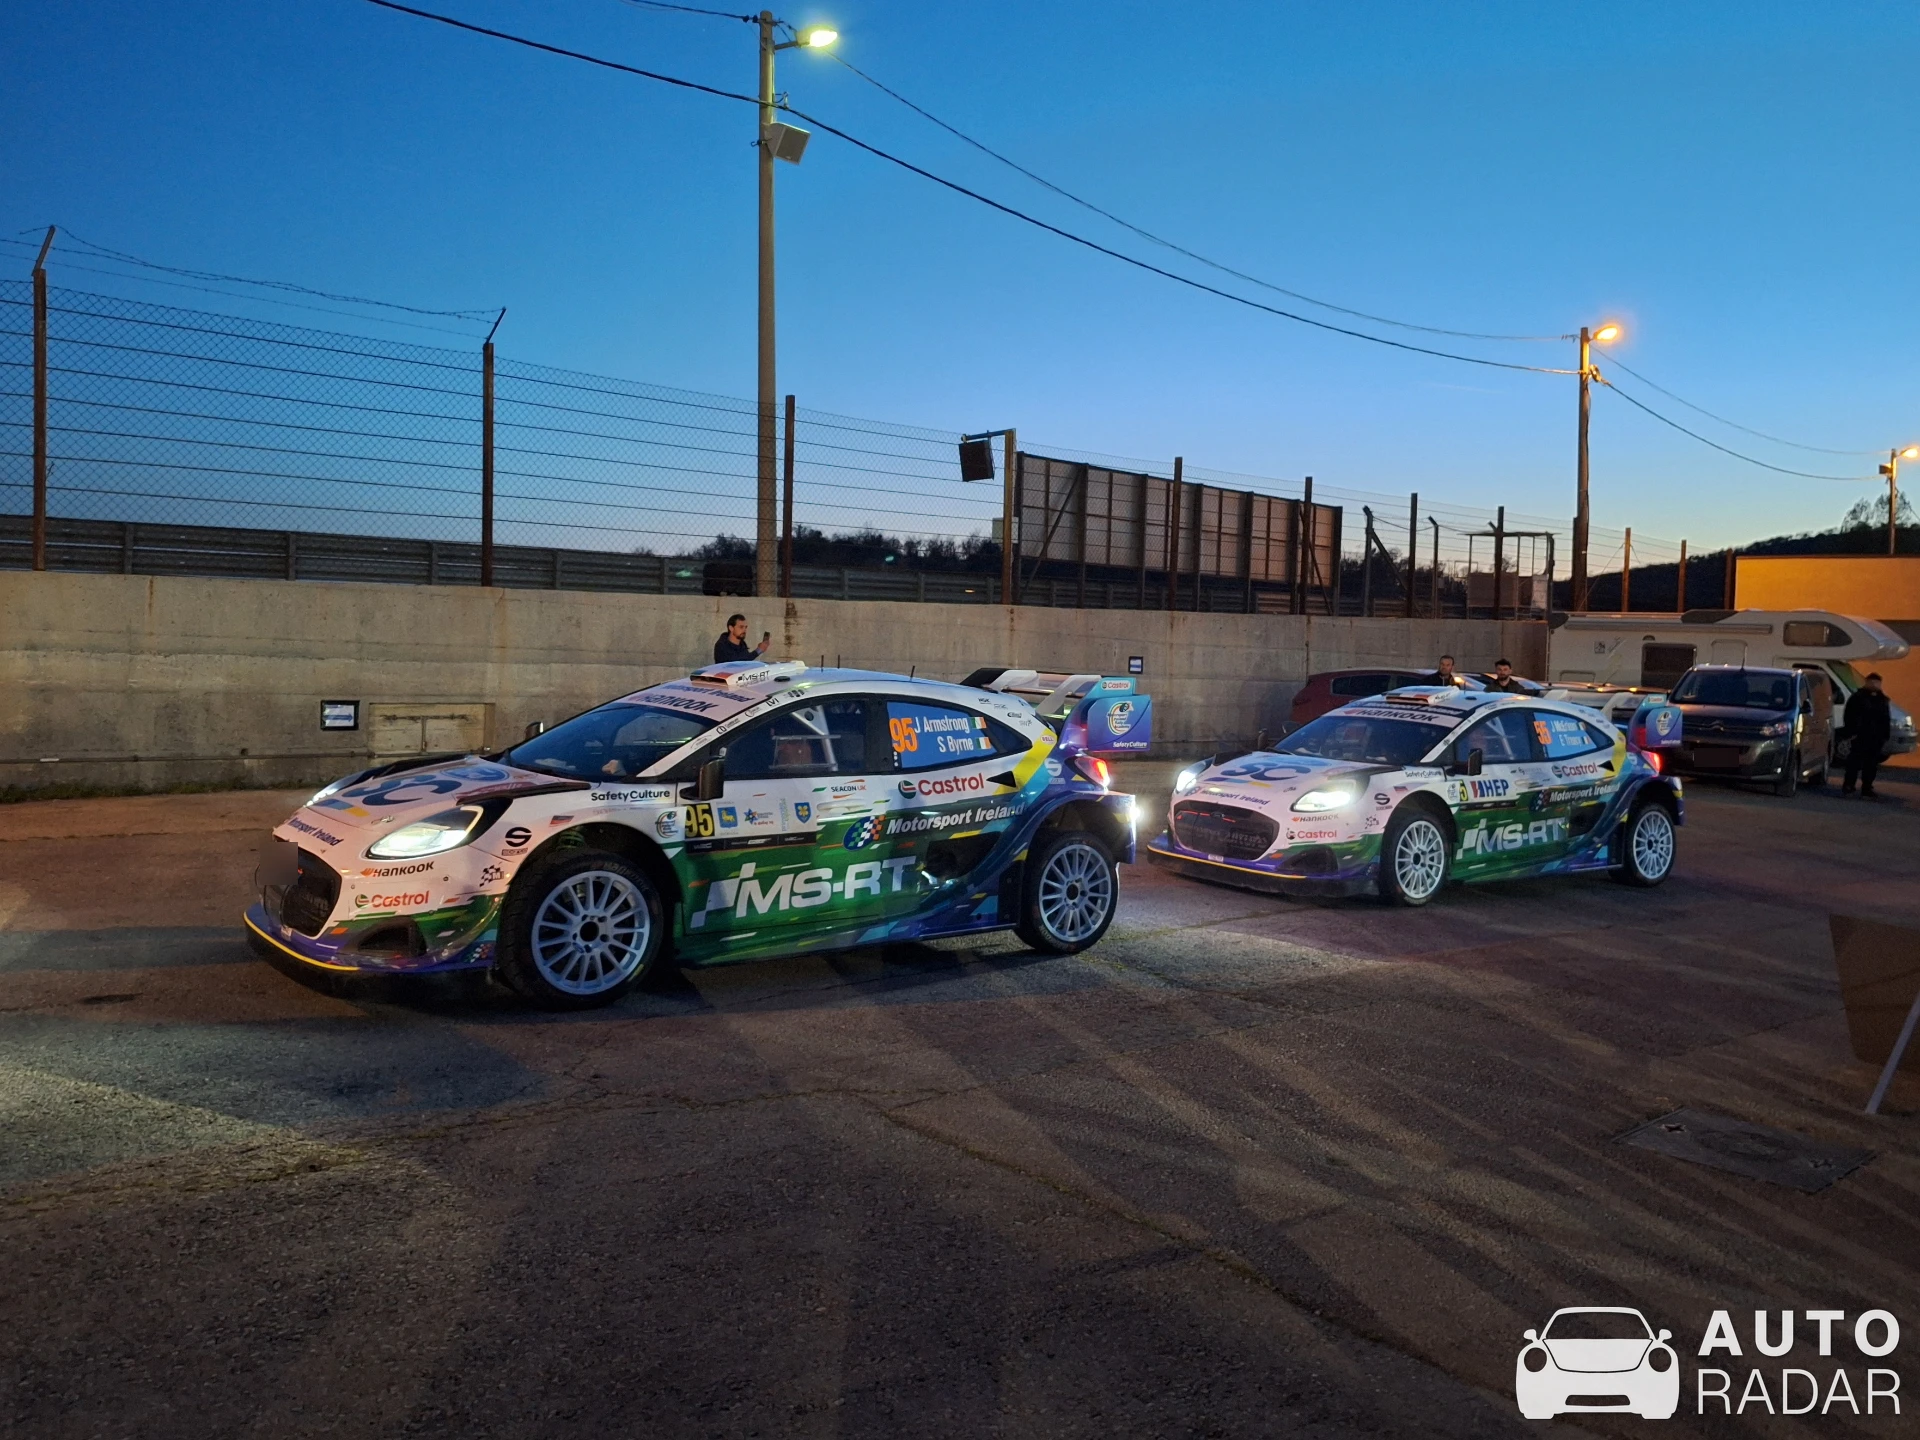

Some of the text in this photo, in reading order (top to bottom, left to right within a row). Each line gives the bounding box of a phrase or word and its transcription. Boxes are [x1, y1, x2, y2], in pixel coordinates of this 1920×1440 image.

[889, 715, 970, 753] 95 J Armstrong
[1534, 720, 1553, 745] 55
[937, 735, 974, 756] S Byrne
[1561, 762, 1598, 777] Castrol
[831, 785, 857, 793] SEACON
[918, 773, 984, 796] Castrol
[1485, 779, 1509, 798] HEP
[1549, 783, 1620, 803] Motorsport Ireland
[591, 789, 671, 802] SafetyCulture
[1239, 794, 1271, 806] Ireland
[685, 804, 714, 838] 95
[887, 803, 1024, 836] Motorsport Ireland
[1297, 830, 1338, 839] Castrol
[1475, 816, 1566, 856] MS-RT
[734, 855, 918, 919] MS-RT
[370, 890, 430, 909] Castrol
